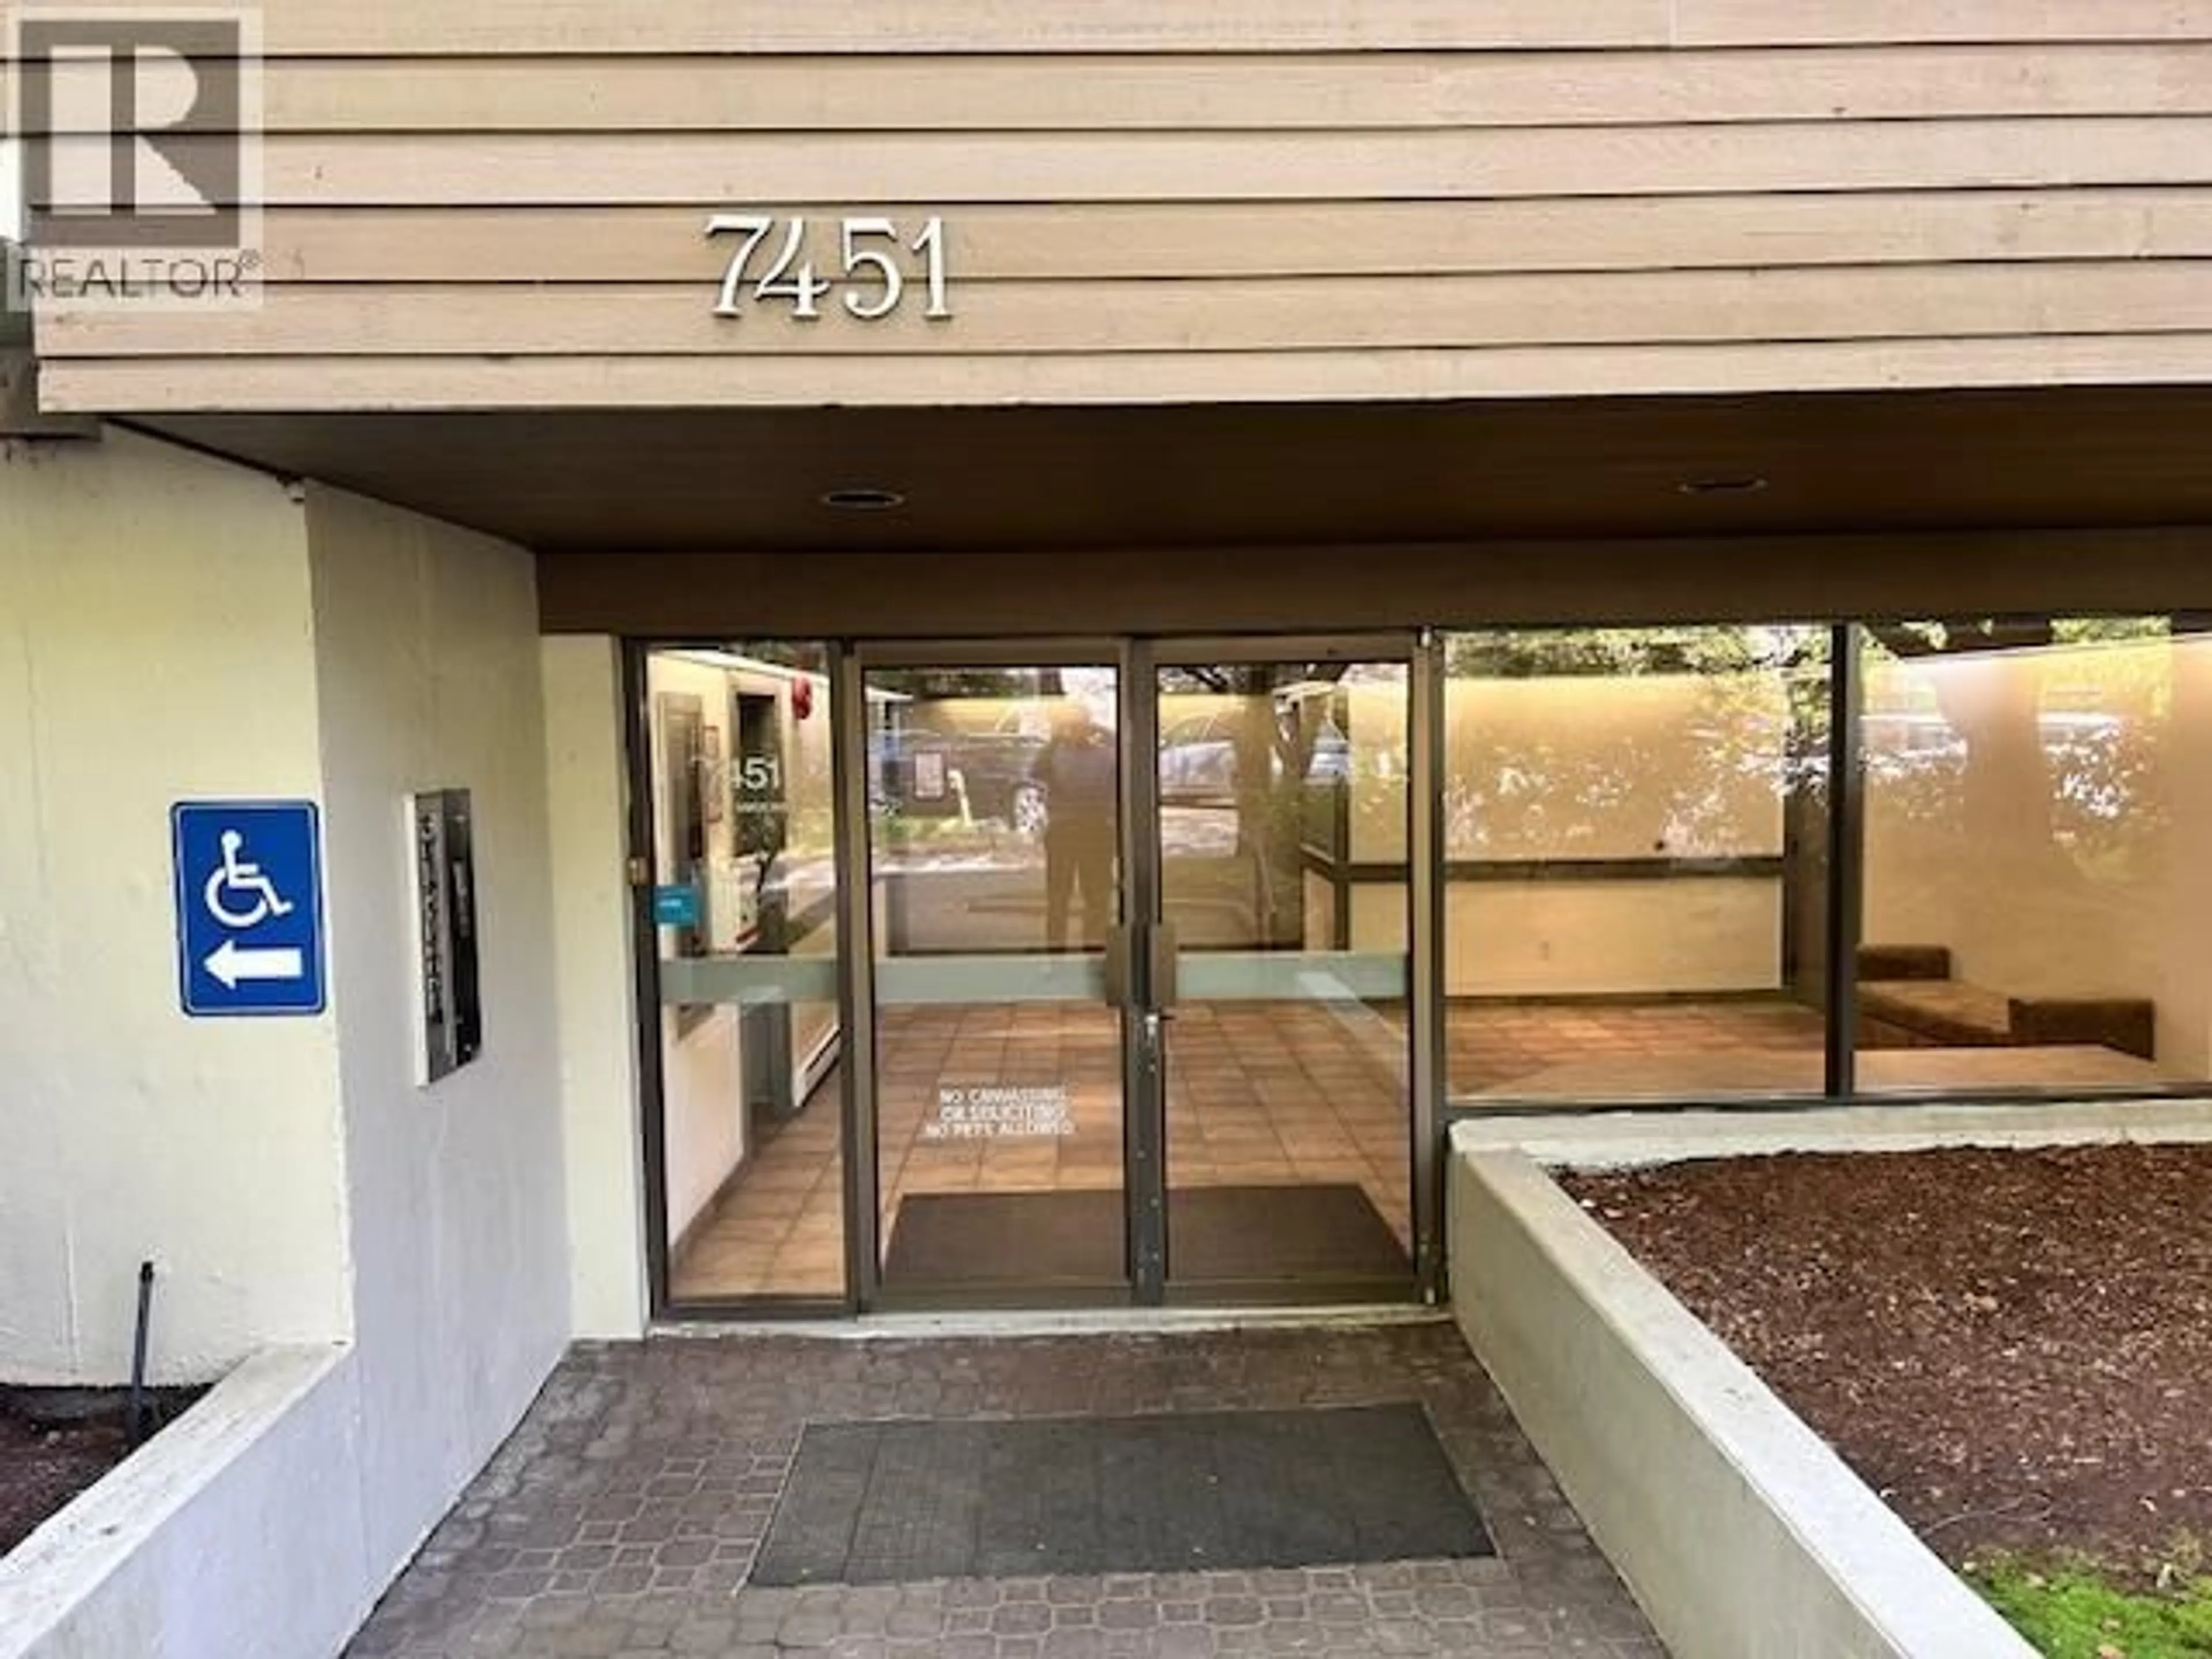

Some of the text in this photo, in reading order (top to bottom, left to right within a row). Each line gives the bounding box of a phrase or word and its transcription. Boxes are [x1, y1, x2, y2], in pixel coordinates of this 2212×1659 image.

[705, 214, 953, 318] 7451
[940, 1089, 965, 1104] NO
[924, 1123, 948, 1139] NO
